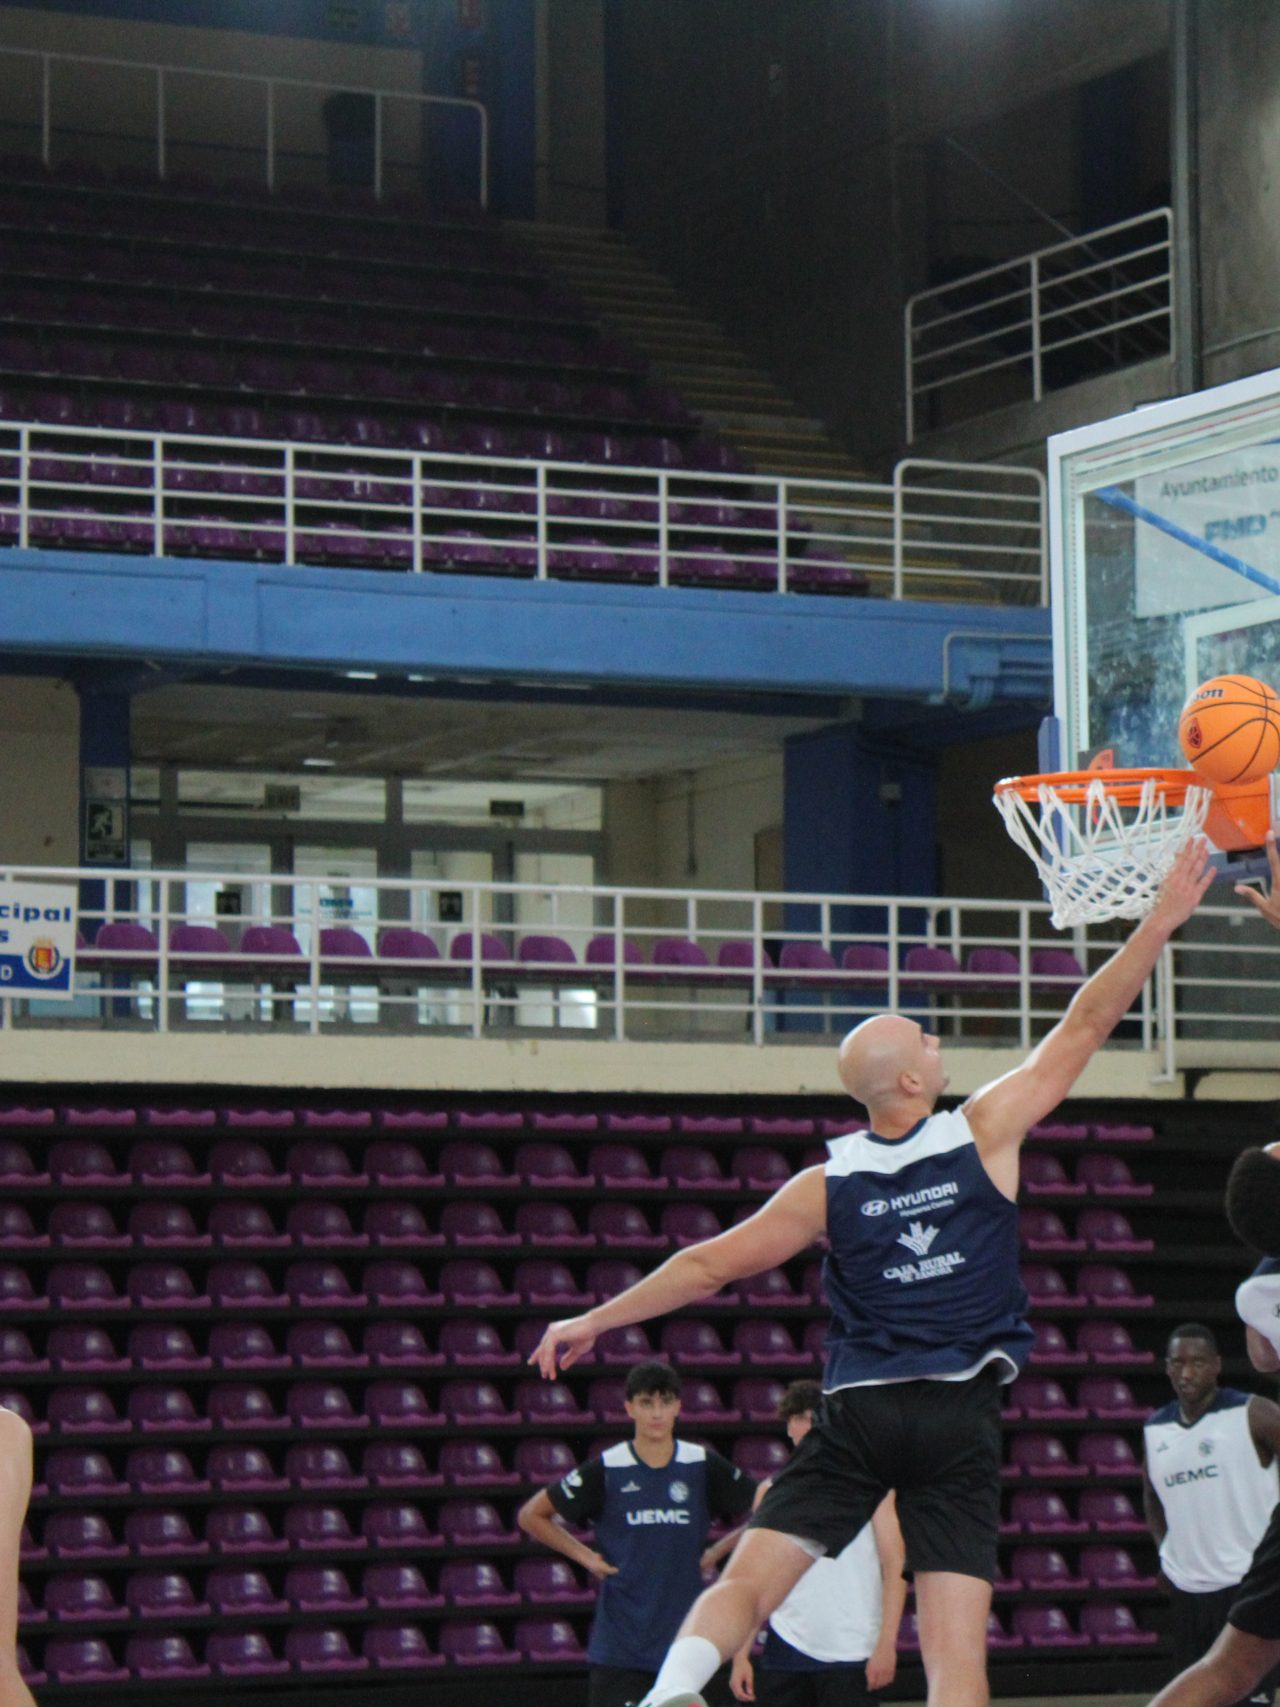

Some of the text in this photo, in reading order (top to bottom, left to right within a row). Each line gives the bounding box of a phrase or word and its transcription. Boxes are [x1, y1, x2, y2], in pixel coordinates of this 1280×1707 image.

[1160, 465, 1279, 502] Ayuntamiento
[891, 1182, 959, 1210] HYUNDAI
[917, 1251, 966, 1272] RURAL
[1164, 1464, 1219, 1489] UEMC
[626, 1509, 691, 1526] UEMC
